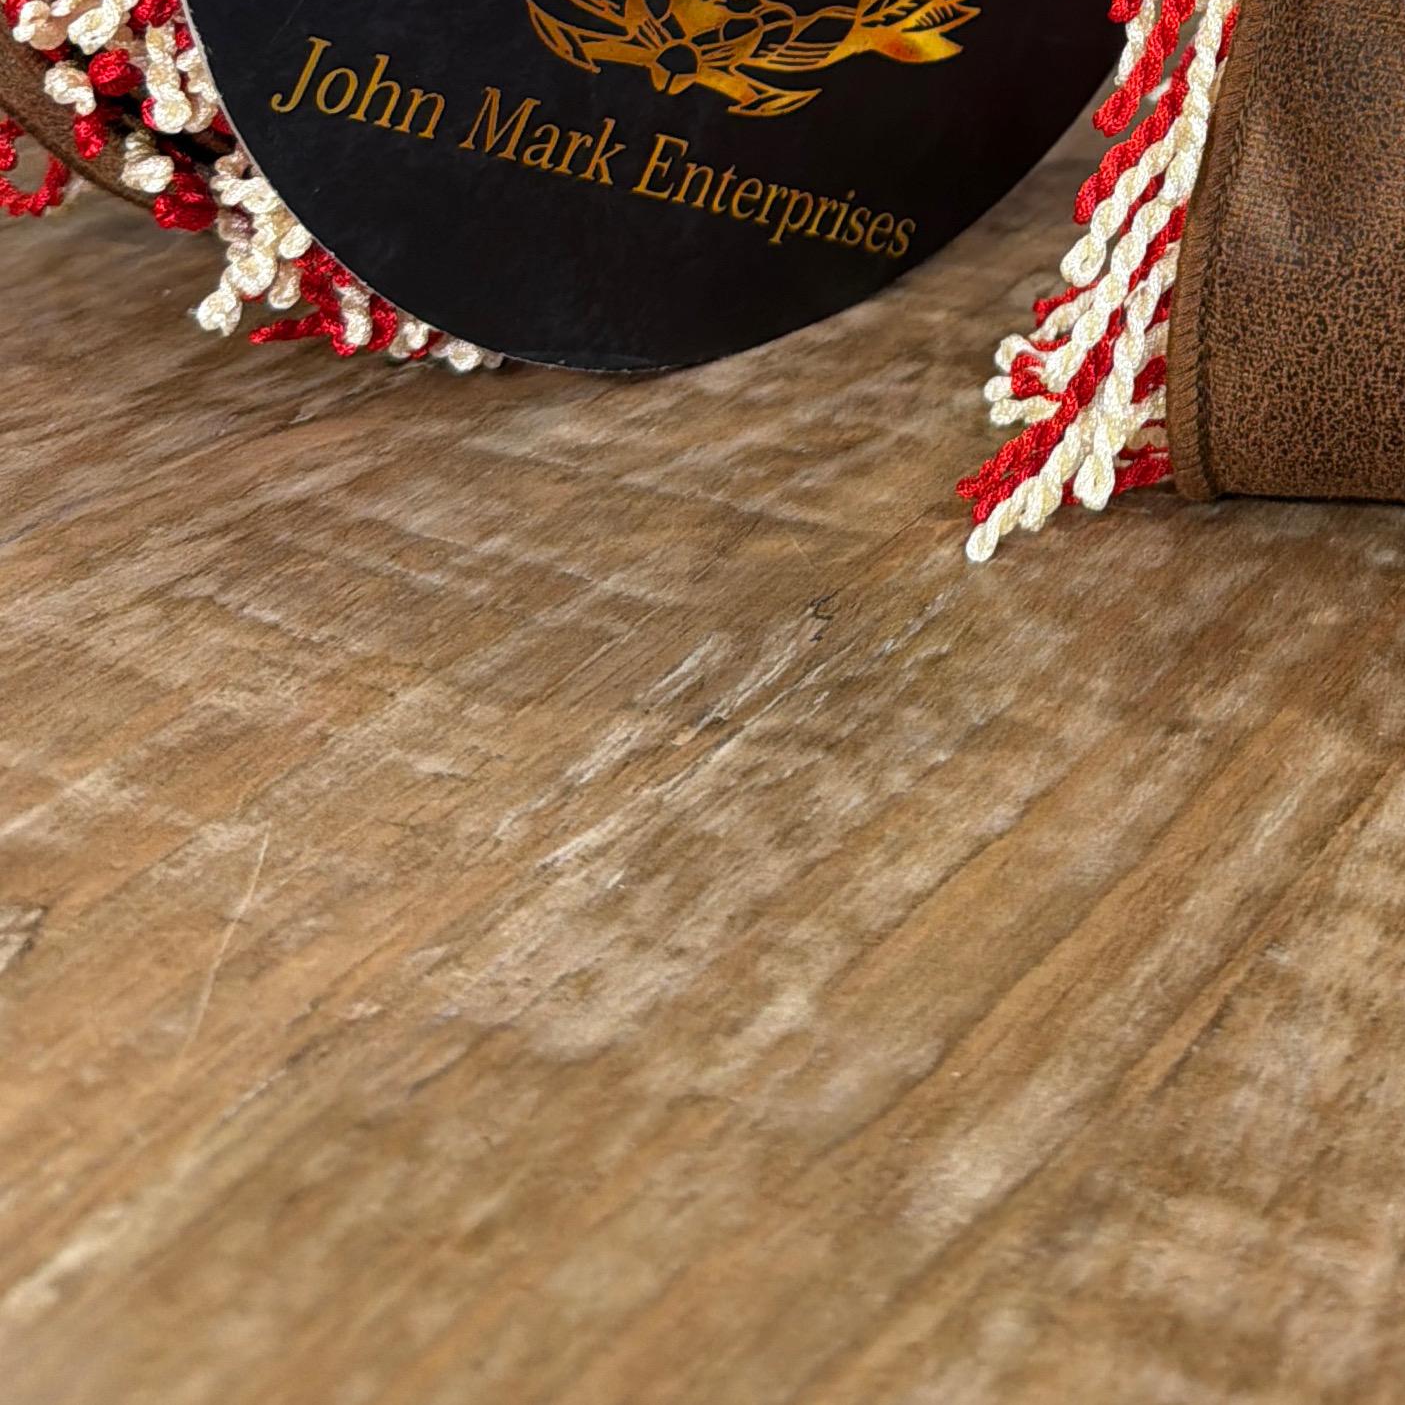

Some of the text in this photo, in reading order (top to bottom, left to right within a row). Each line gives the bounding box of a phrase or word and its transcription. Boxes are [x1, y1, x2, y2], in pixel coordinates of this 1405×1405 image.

[271, 36, 916, 259] John Mark Enterprises
